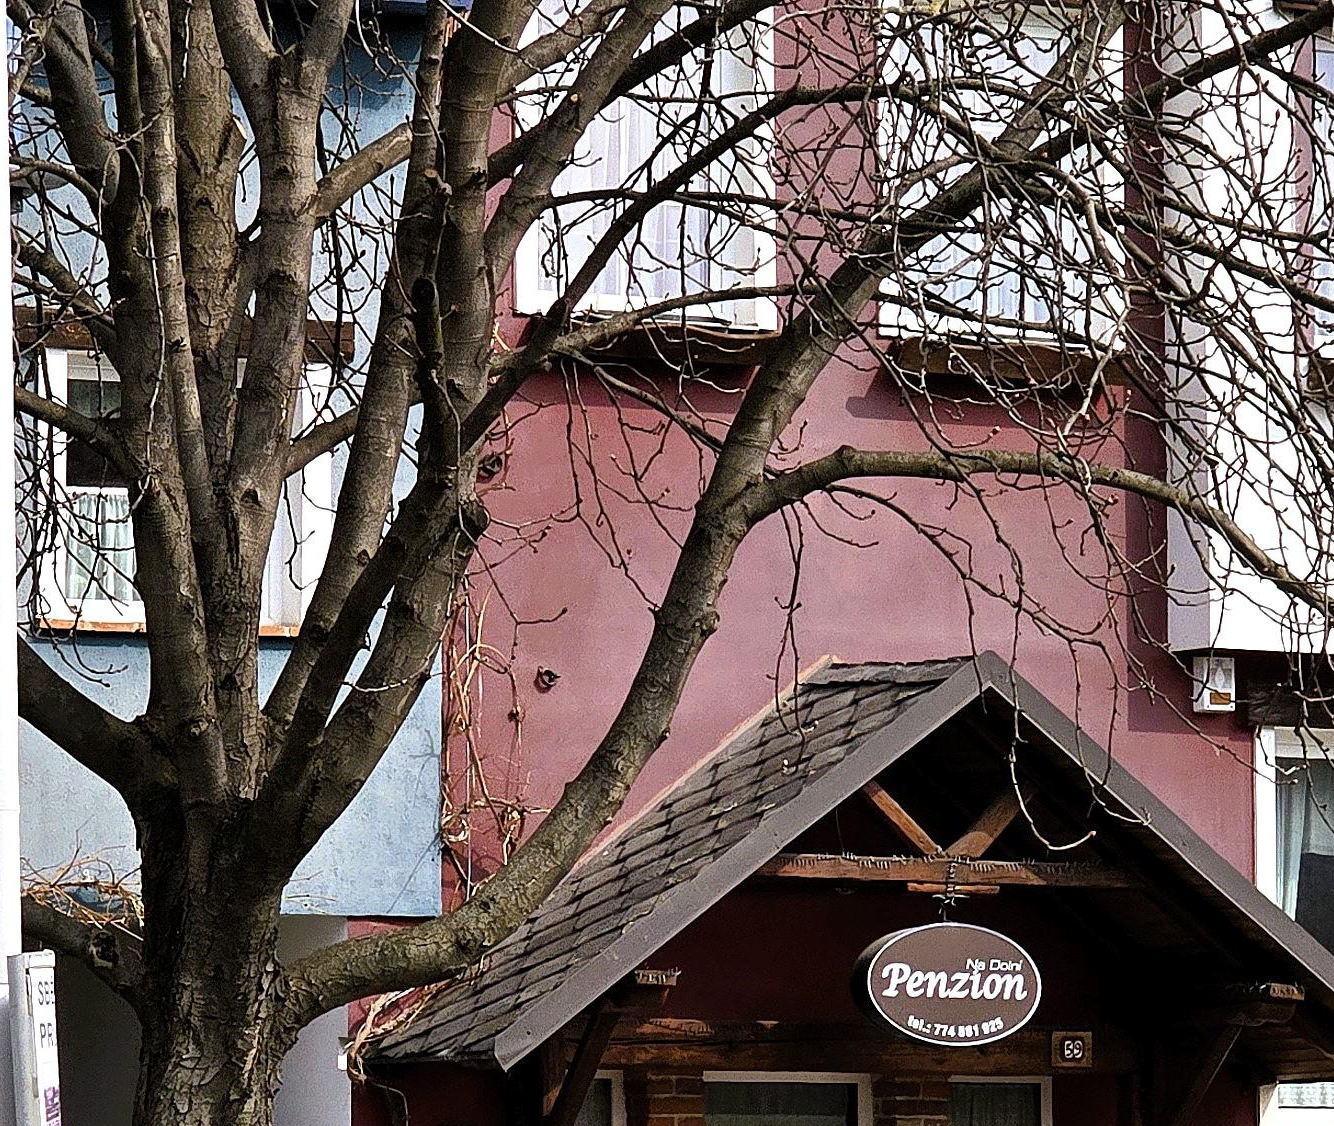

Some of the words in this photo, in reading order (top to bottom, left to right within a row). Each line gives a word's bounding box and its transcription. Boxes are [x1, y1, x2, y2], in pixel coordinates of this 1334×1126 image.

[966, 958, 986, 971] Na
[881, 962, 1028, 1001] Penzion
[933, 1023, 957, 1038] 774
